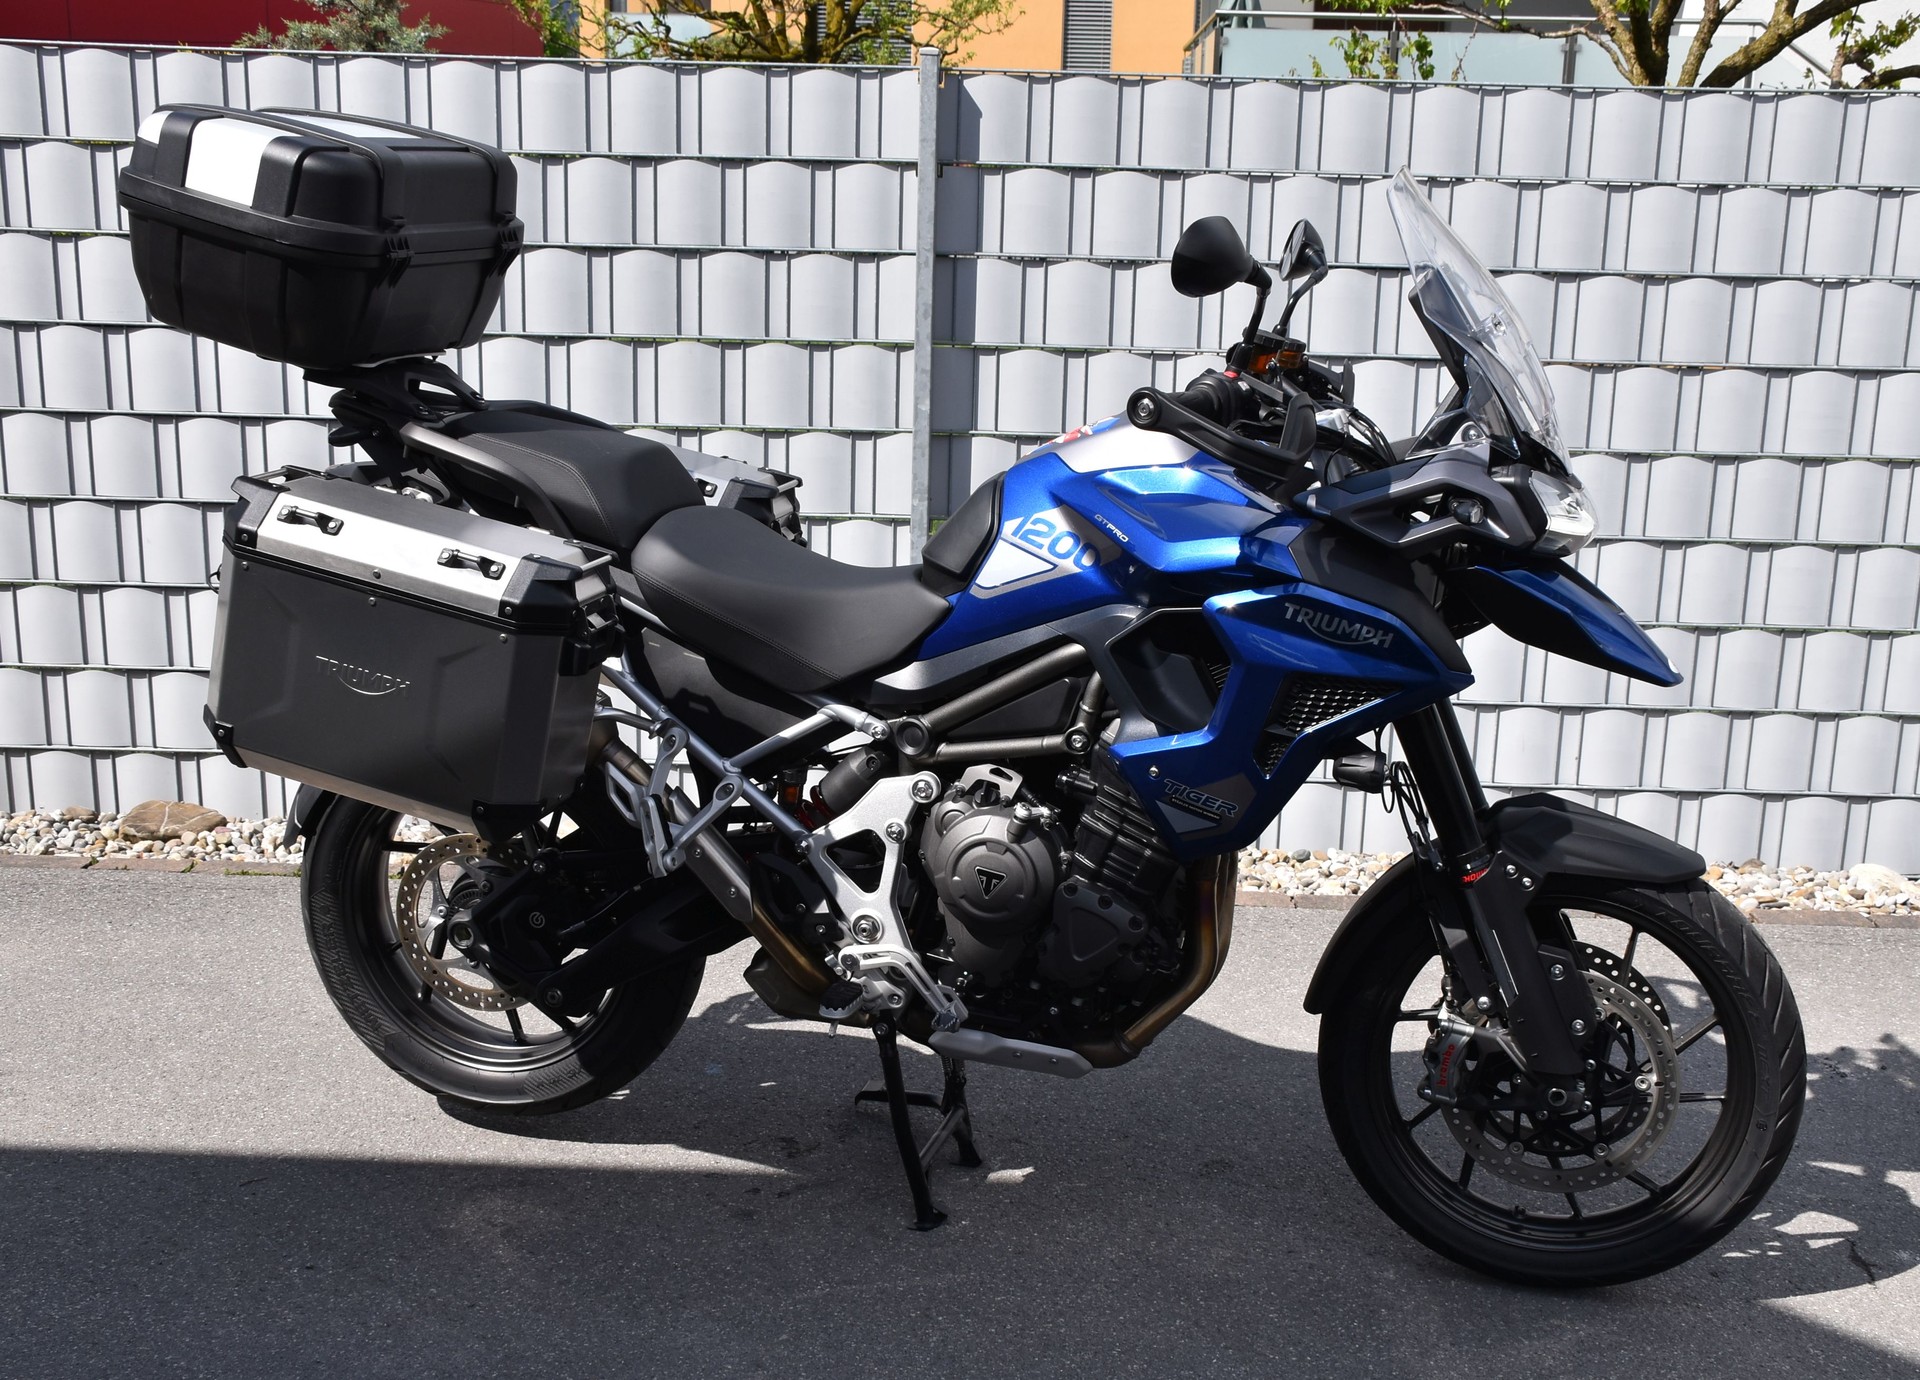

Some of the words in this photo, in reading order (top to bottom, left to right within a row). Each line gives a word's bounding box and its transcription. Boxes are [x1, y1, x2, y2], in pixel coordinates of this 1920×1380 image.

[1010, 515, 1099, 571] 1200
[1284, 602, 1394, 648] TRIUMPH
[316, 655, 410, 697] TRIUMPH
[1163, 778, 1239, 818] TIGER
[1437, 1043, 1456, 1088] brembo
